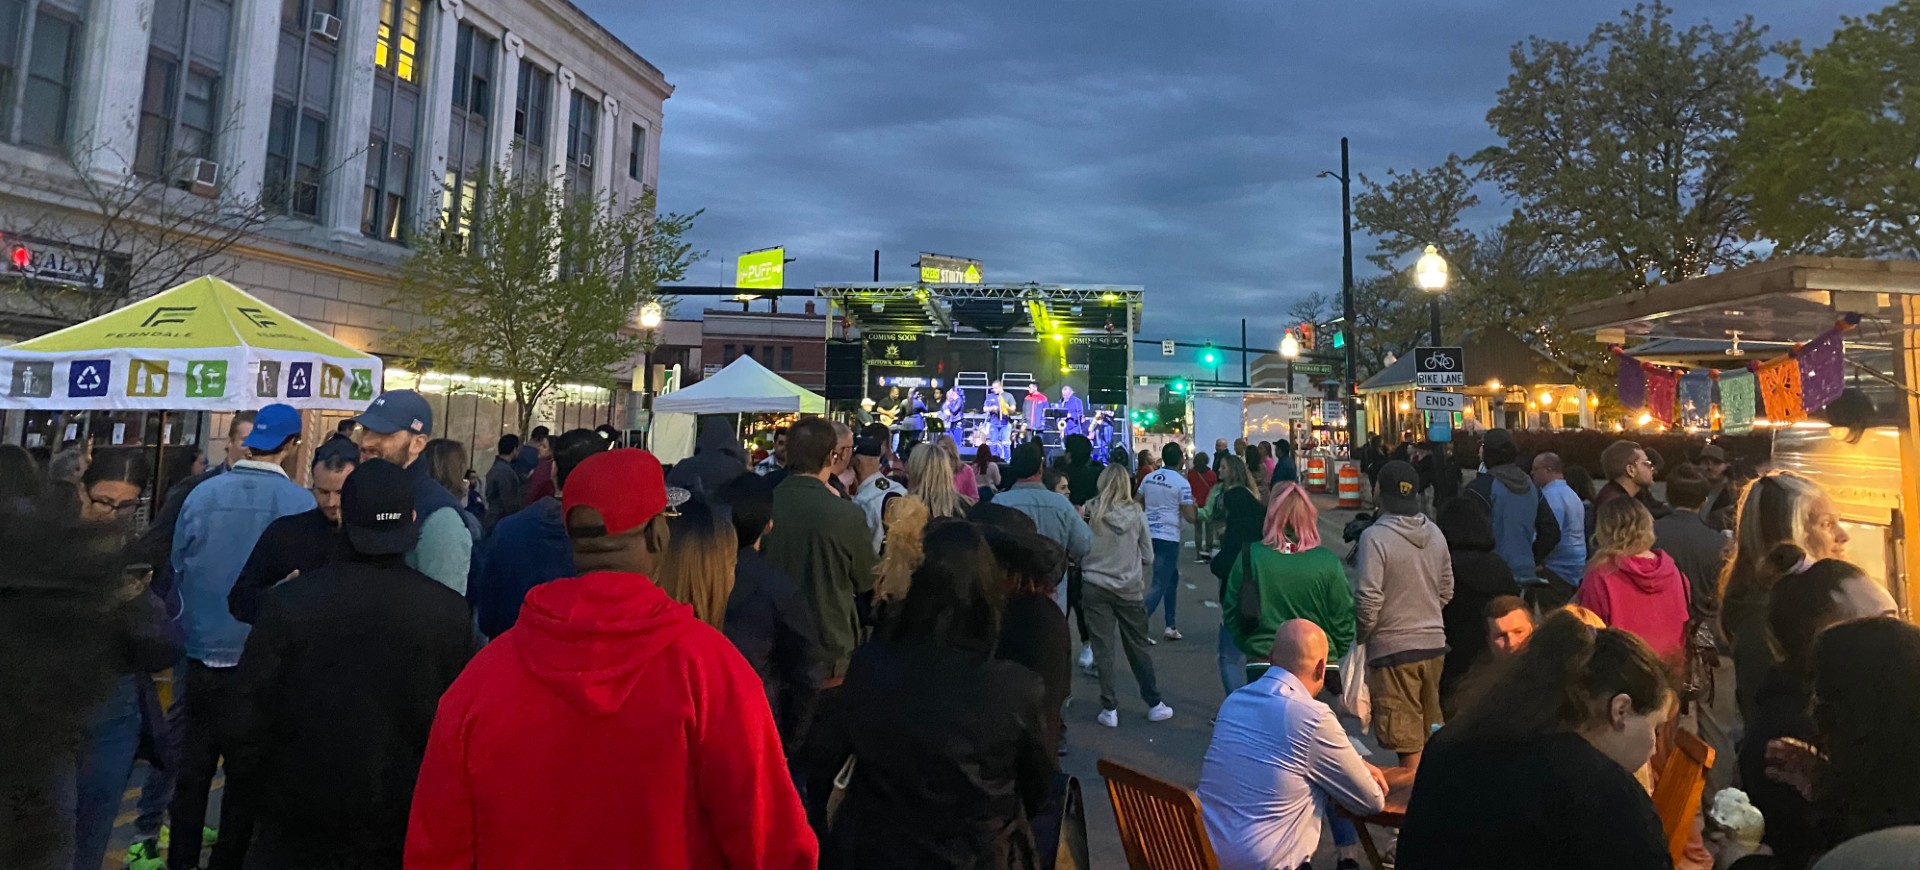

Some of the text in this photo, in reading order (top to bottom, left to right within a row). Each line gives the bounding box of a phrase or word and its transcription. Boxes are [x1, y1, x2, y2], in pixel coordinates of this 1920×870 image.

[748, 262, 772, 278] PUFF
[1418, 374, 1463, 384] BIKE LANE
[1425, 395, 1454, 407] ENDS
[376, 512, 402, 521] DETROIT
